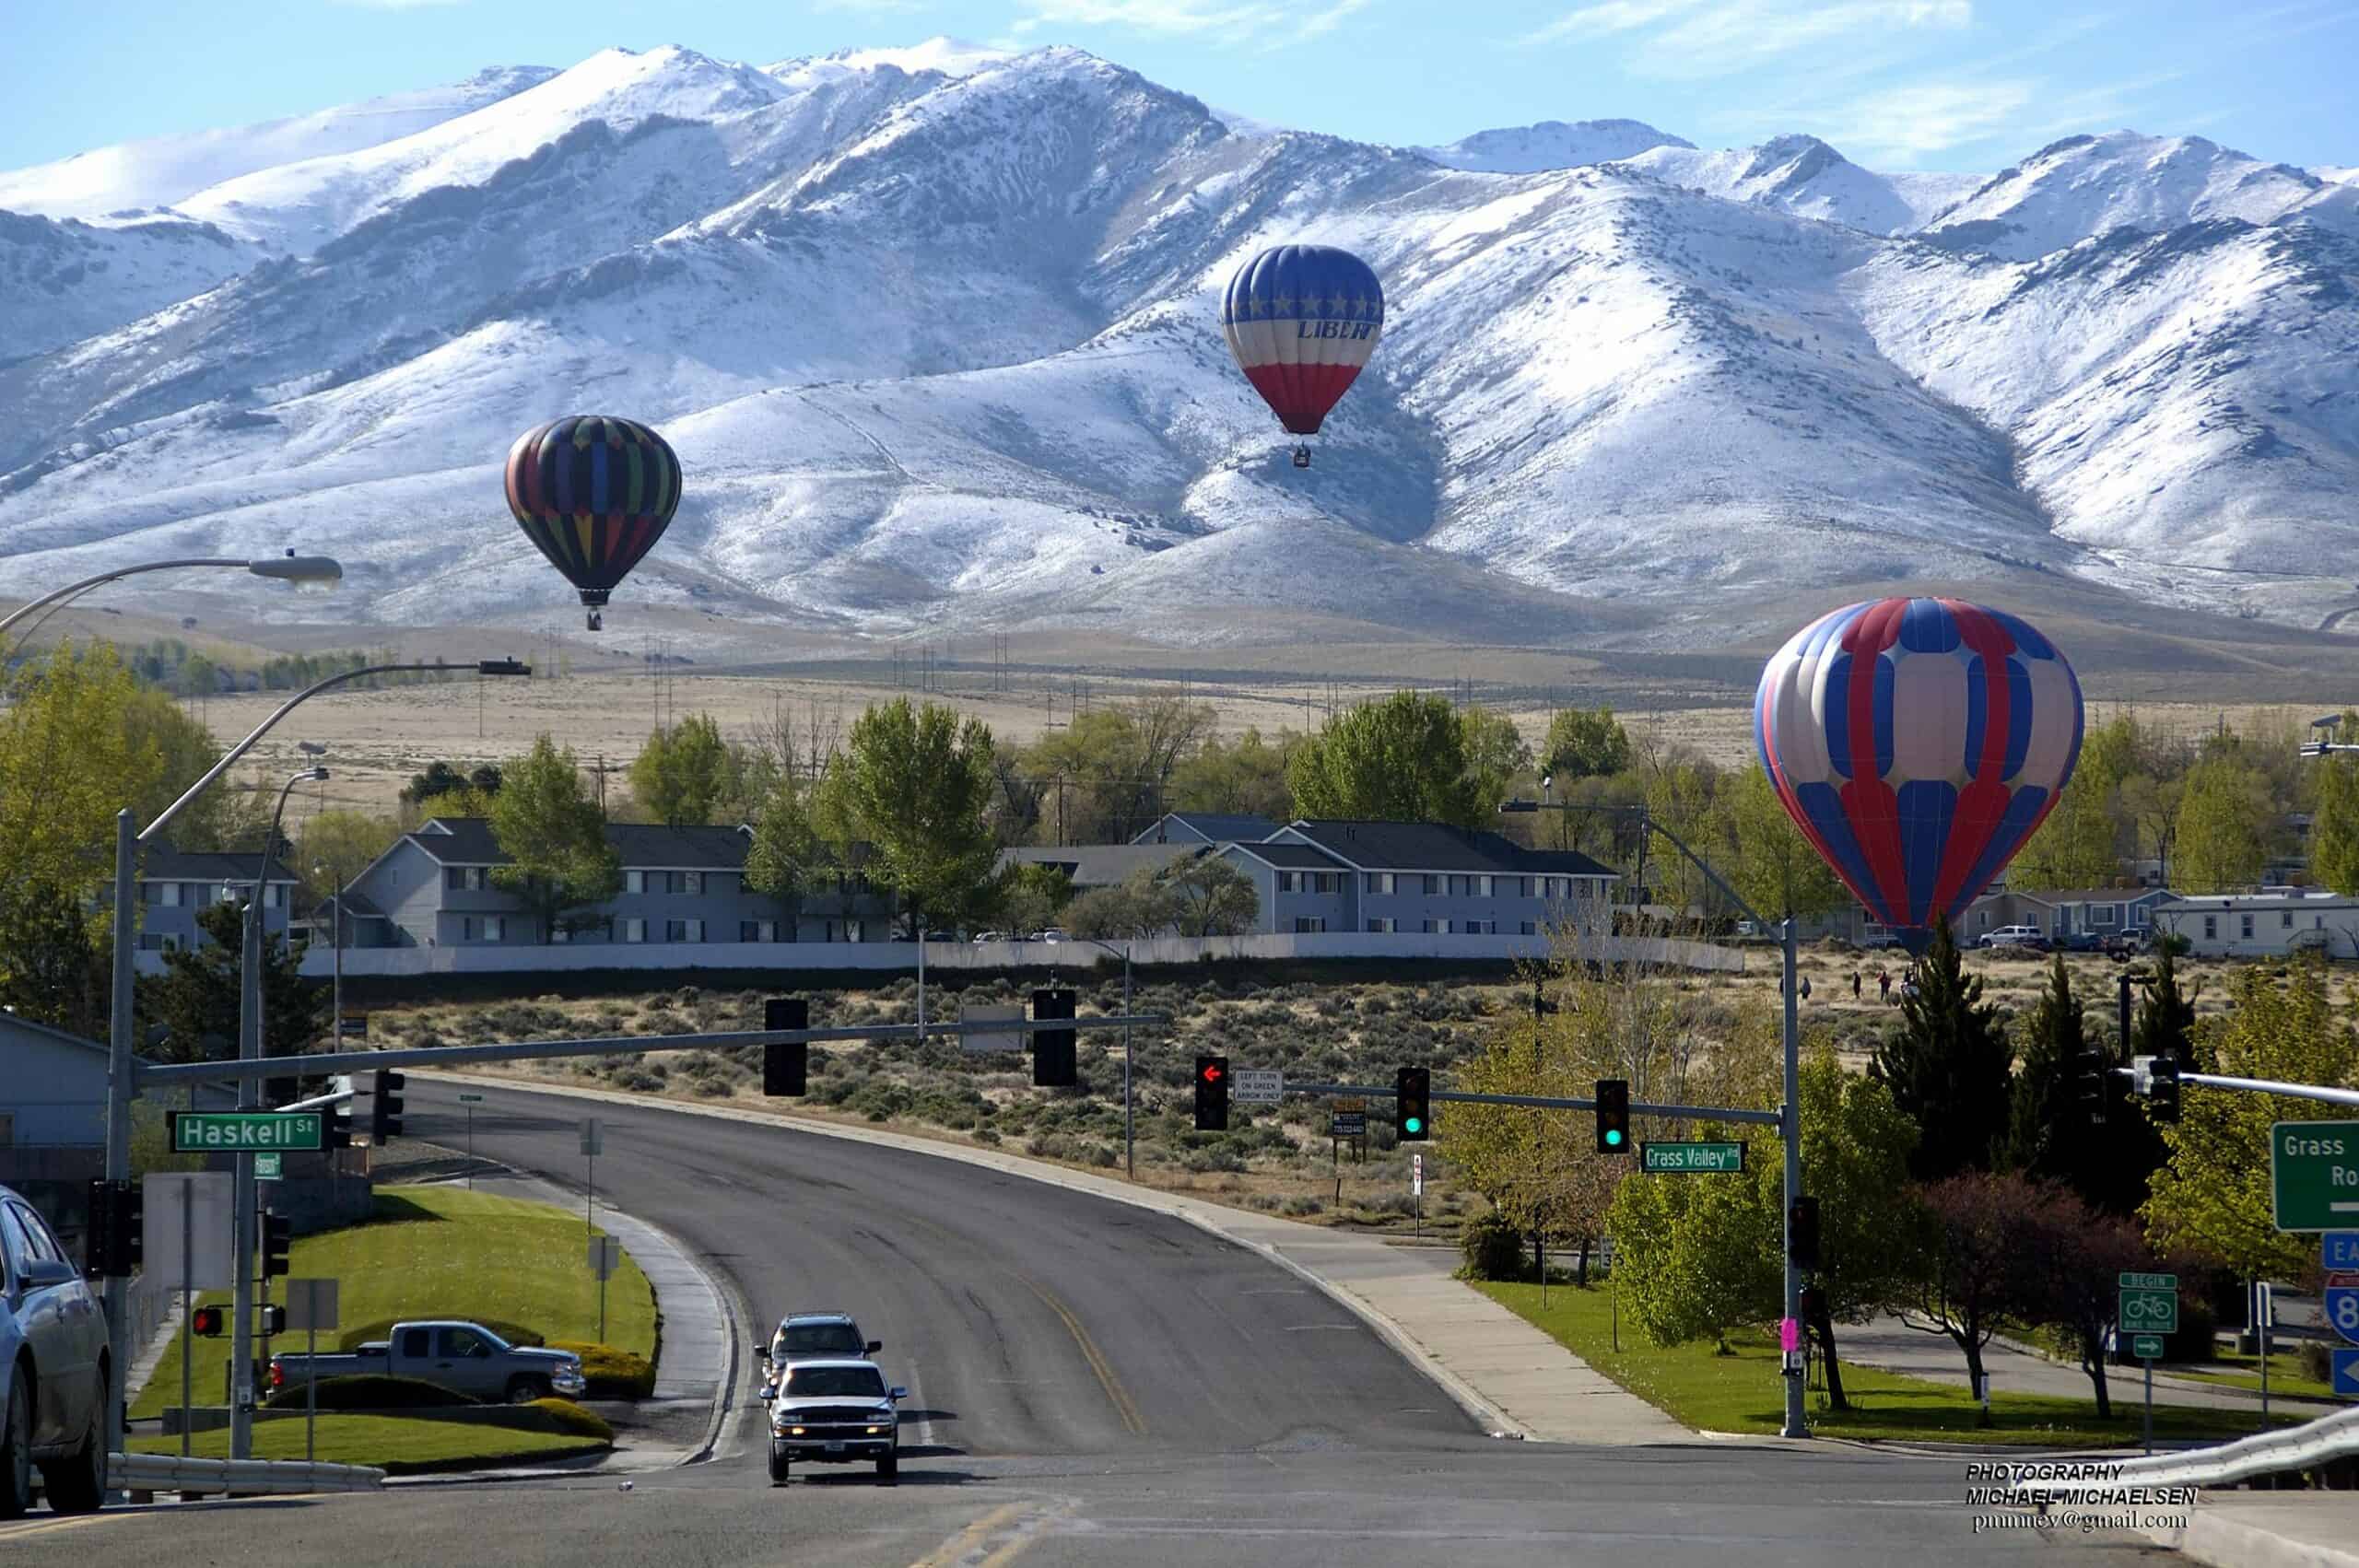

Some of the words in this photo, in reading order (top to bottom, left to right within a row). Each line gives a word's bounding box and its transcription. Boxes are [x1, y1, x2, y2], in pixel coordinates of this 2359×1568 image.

[185, 1120, 291, 1143] Haskell
[296, 1119, 313, 1132] St
[2285, 1135, 2344, 1156] Grass
[1646, 1148, 1684, 1166] Grass
[1686, 1148, 1726, 1169] Valley
[2131, 1274, 2165, 1287] BEGIN
